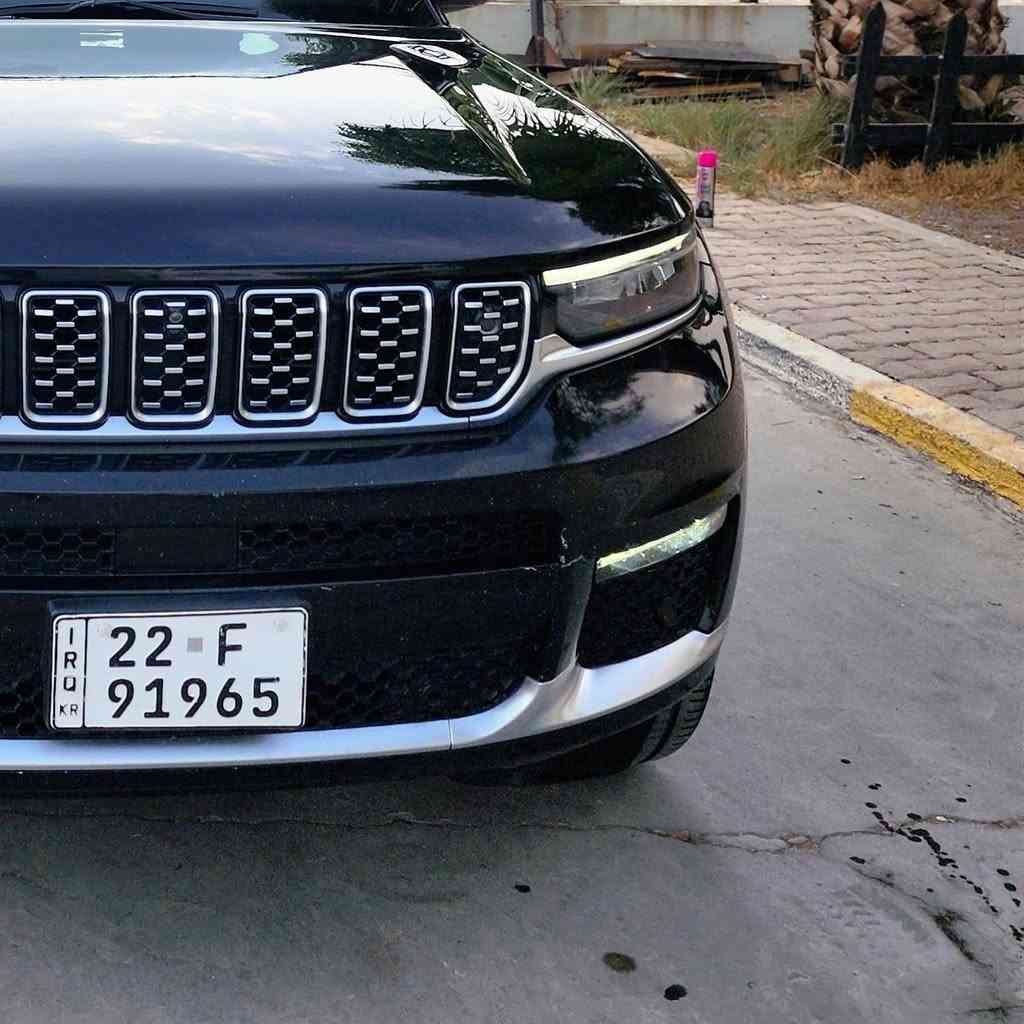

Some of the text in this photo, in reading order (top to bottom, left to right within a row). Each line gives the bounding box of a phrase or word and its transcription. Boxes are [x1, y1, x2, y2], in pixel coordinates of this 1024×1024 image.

[109, 623, 247, 668] 22 F
[59, 703, 79, 716] KR
[108, 677, 280, 719] 91965
